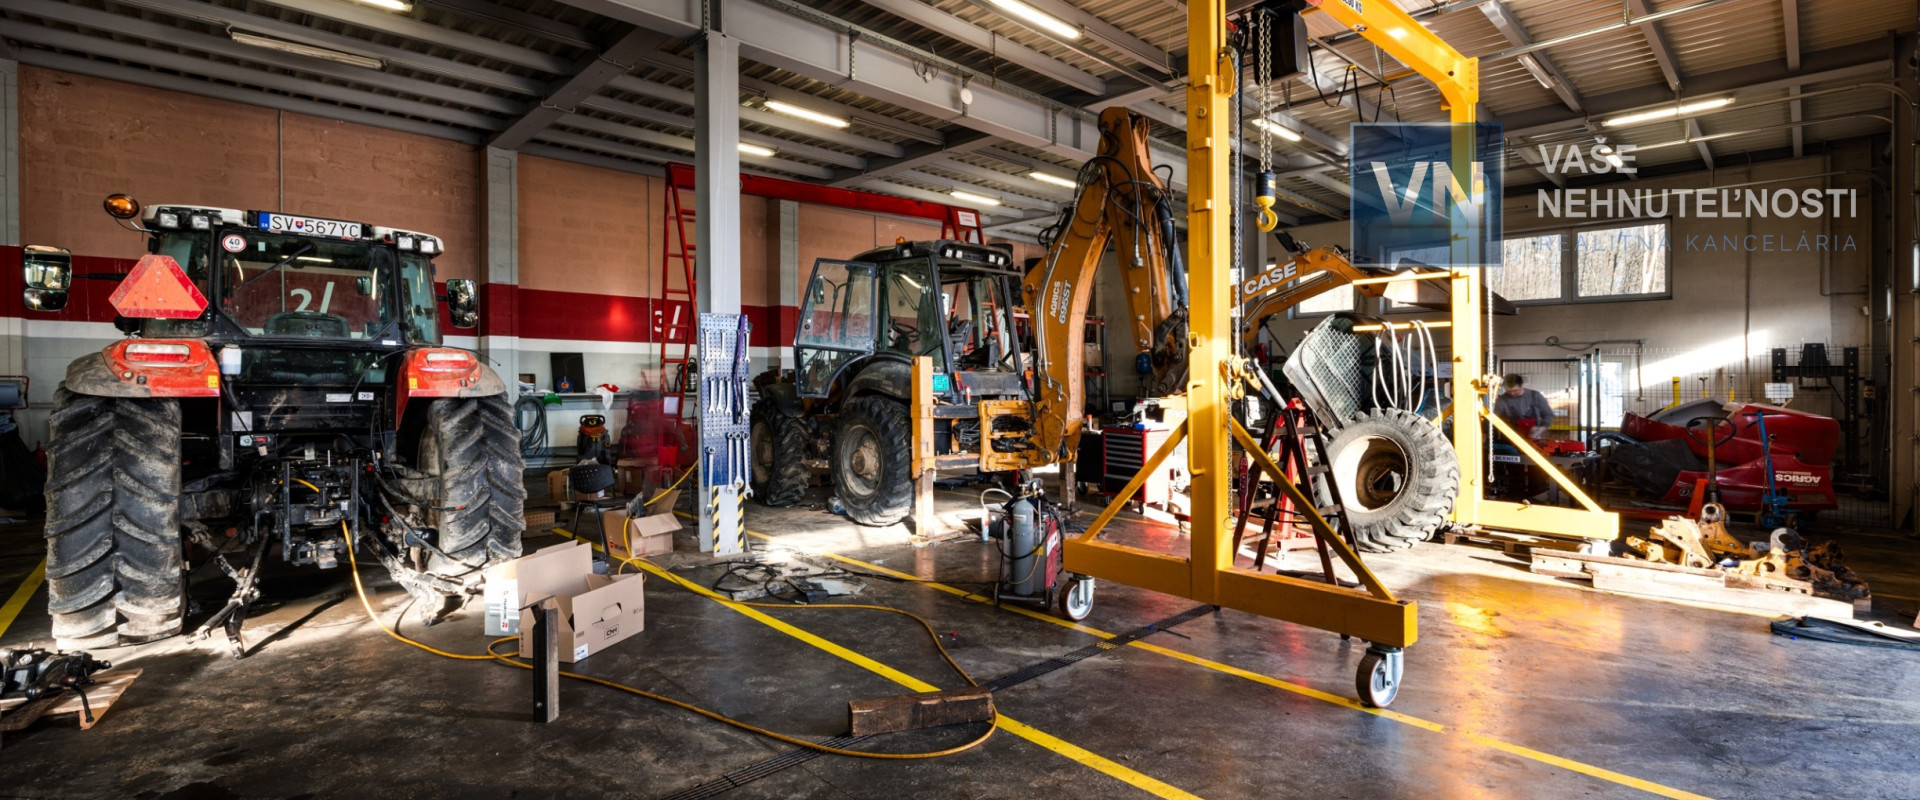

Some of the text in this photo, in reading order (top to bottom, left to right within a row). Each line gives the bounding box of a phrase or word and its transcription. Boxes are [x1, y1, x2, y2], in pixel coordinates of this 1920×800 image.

[272, 215, 360, 238] SV 567YC
[228, 238, 241, 246] 40
[1244, 261, 1297, 294] CASE
[1050, 281, 1061, 317] AGRICS
[1775, 474, 1822, 484] AGRICS
